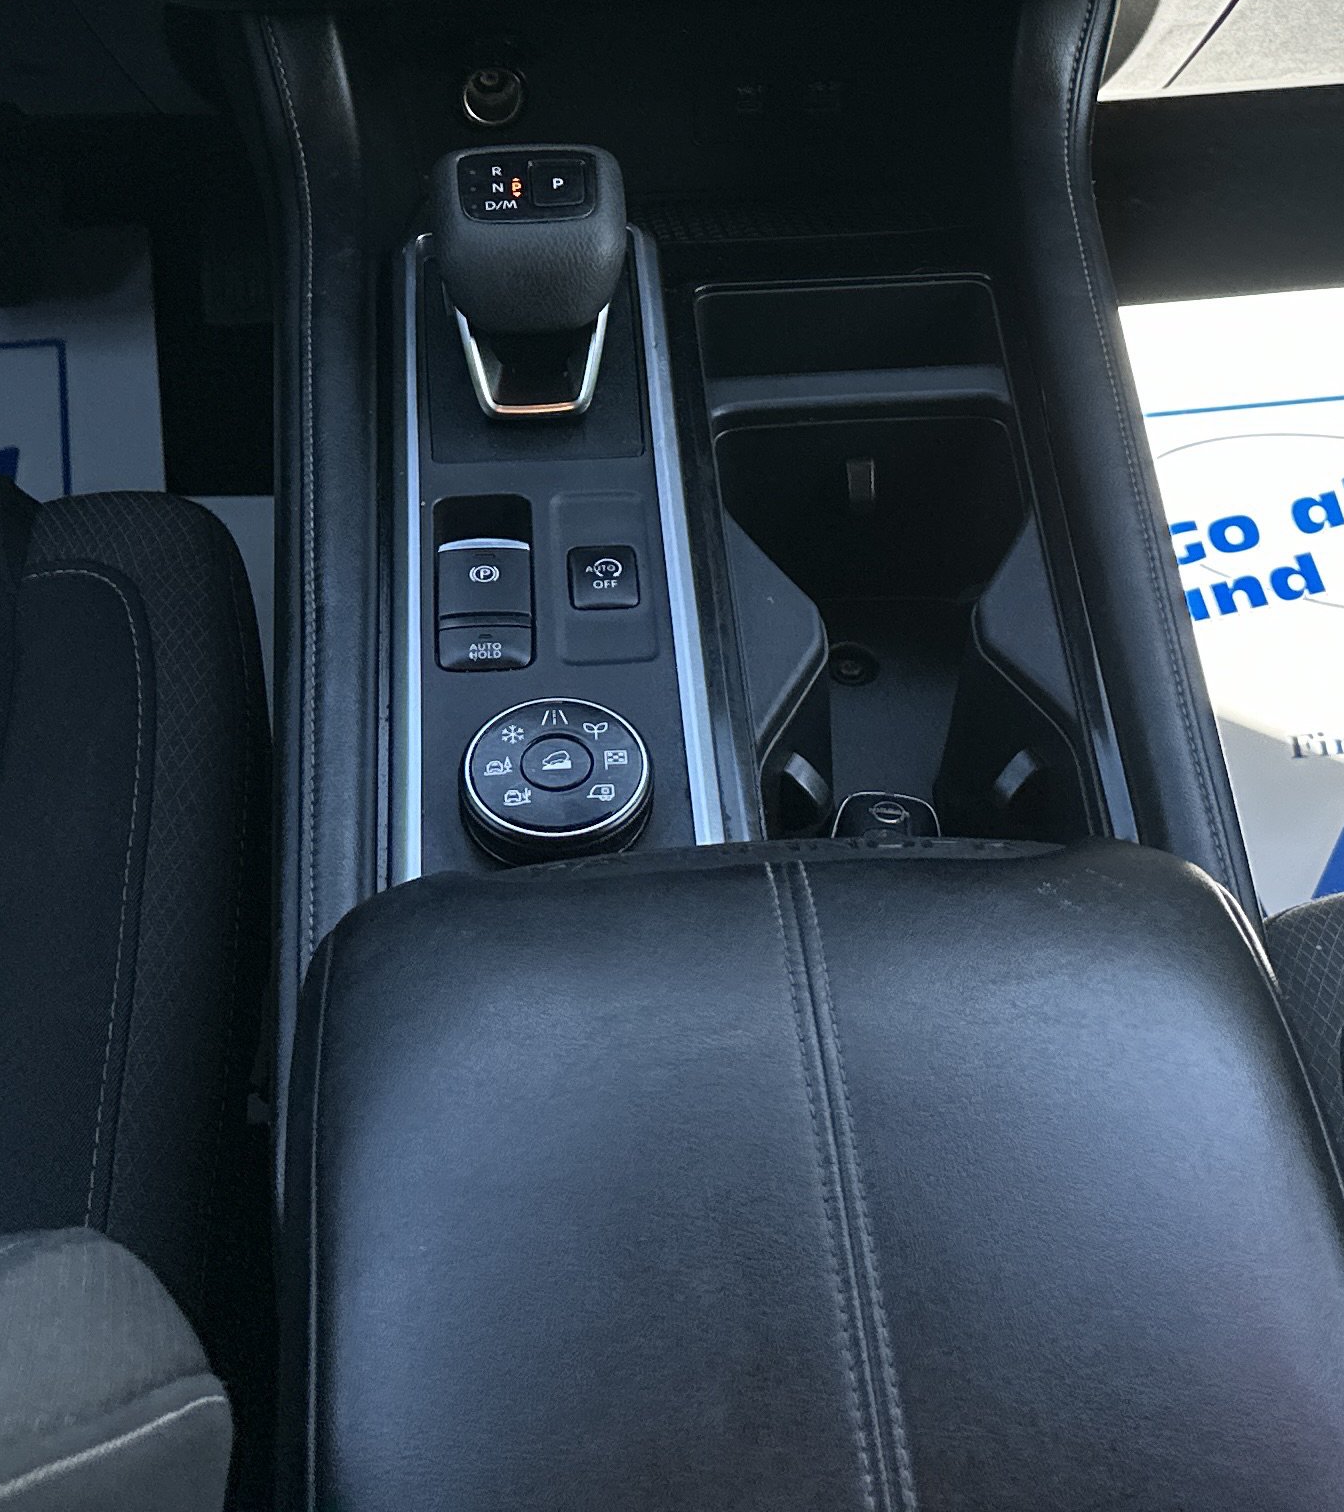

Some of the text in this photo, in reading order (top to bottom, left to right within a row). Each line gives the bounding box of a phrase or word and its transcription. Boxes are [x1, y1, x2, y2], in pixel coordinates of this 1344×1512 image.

[491, 166, 502, 177] R
[492, 182, 504, 193] N
[552, 177, 564, 189] P
[485, 199, 518, 211] D/M
[592, 579, 619, 590] OFF
[469, 642, 502, 652] AUTO
